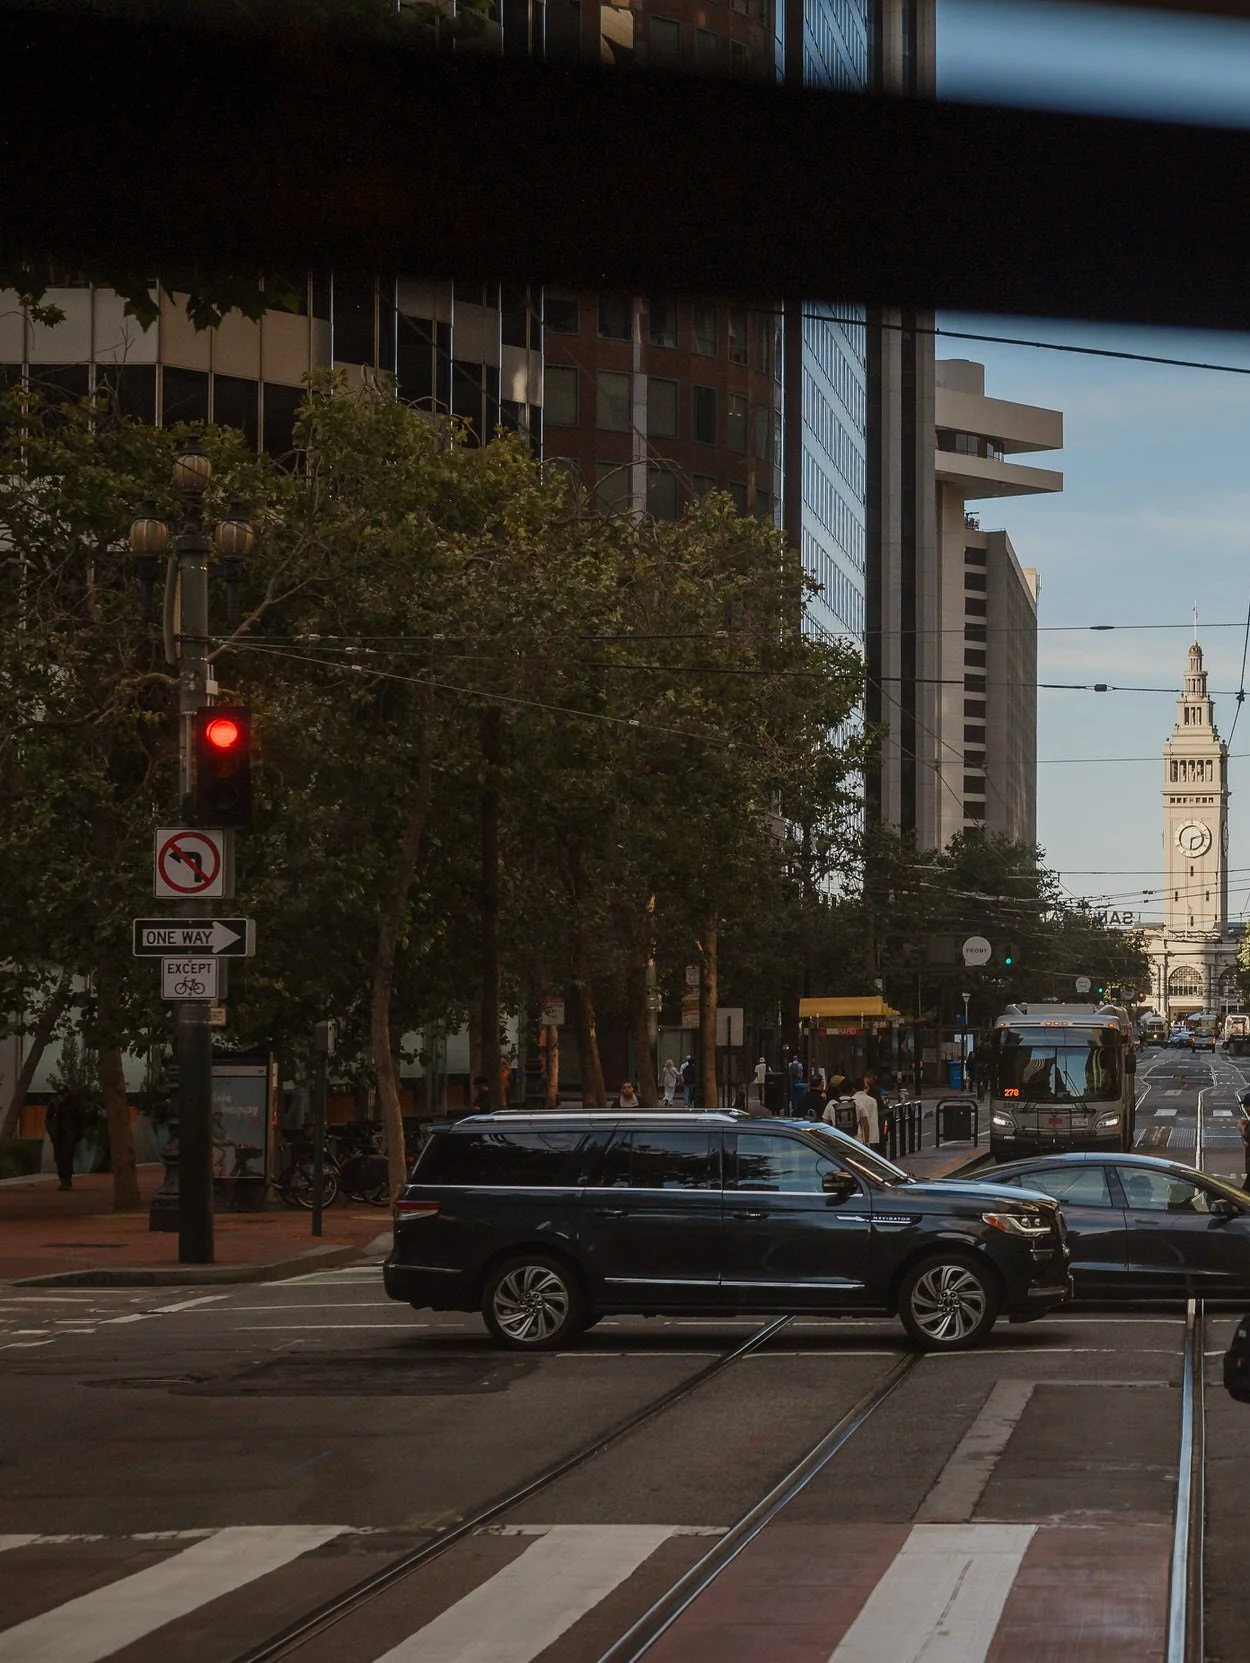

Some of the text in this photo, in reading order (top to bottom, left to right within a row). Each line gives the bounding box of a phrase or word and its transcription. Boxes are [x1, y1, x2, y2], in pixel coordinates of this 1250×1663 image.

[146, 931, 213, 945] ONE WAY
[167, 963, 213, 974] EXCEPT
